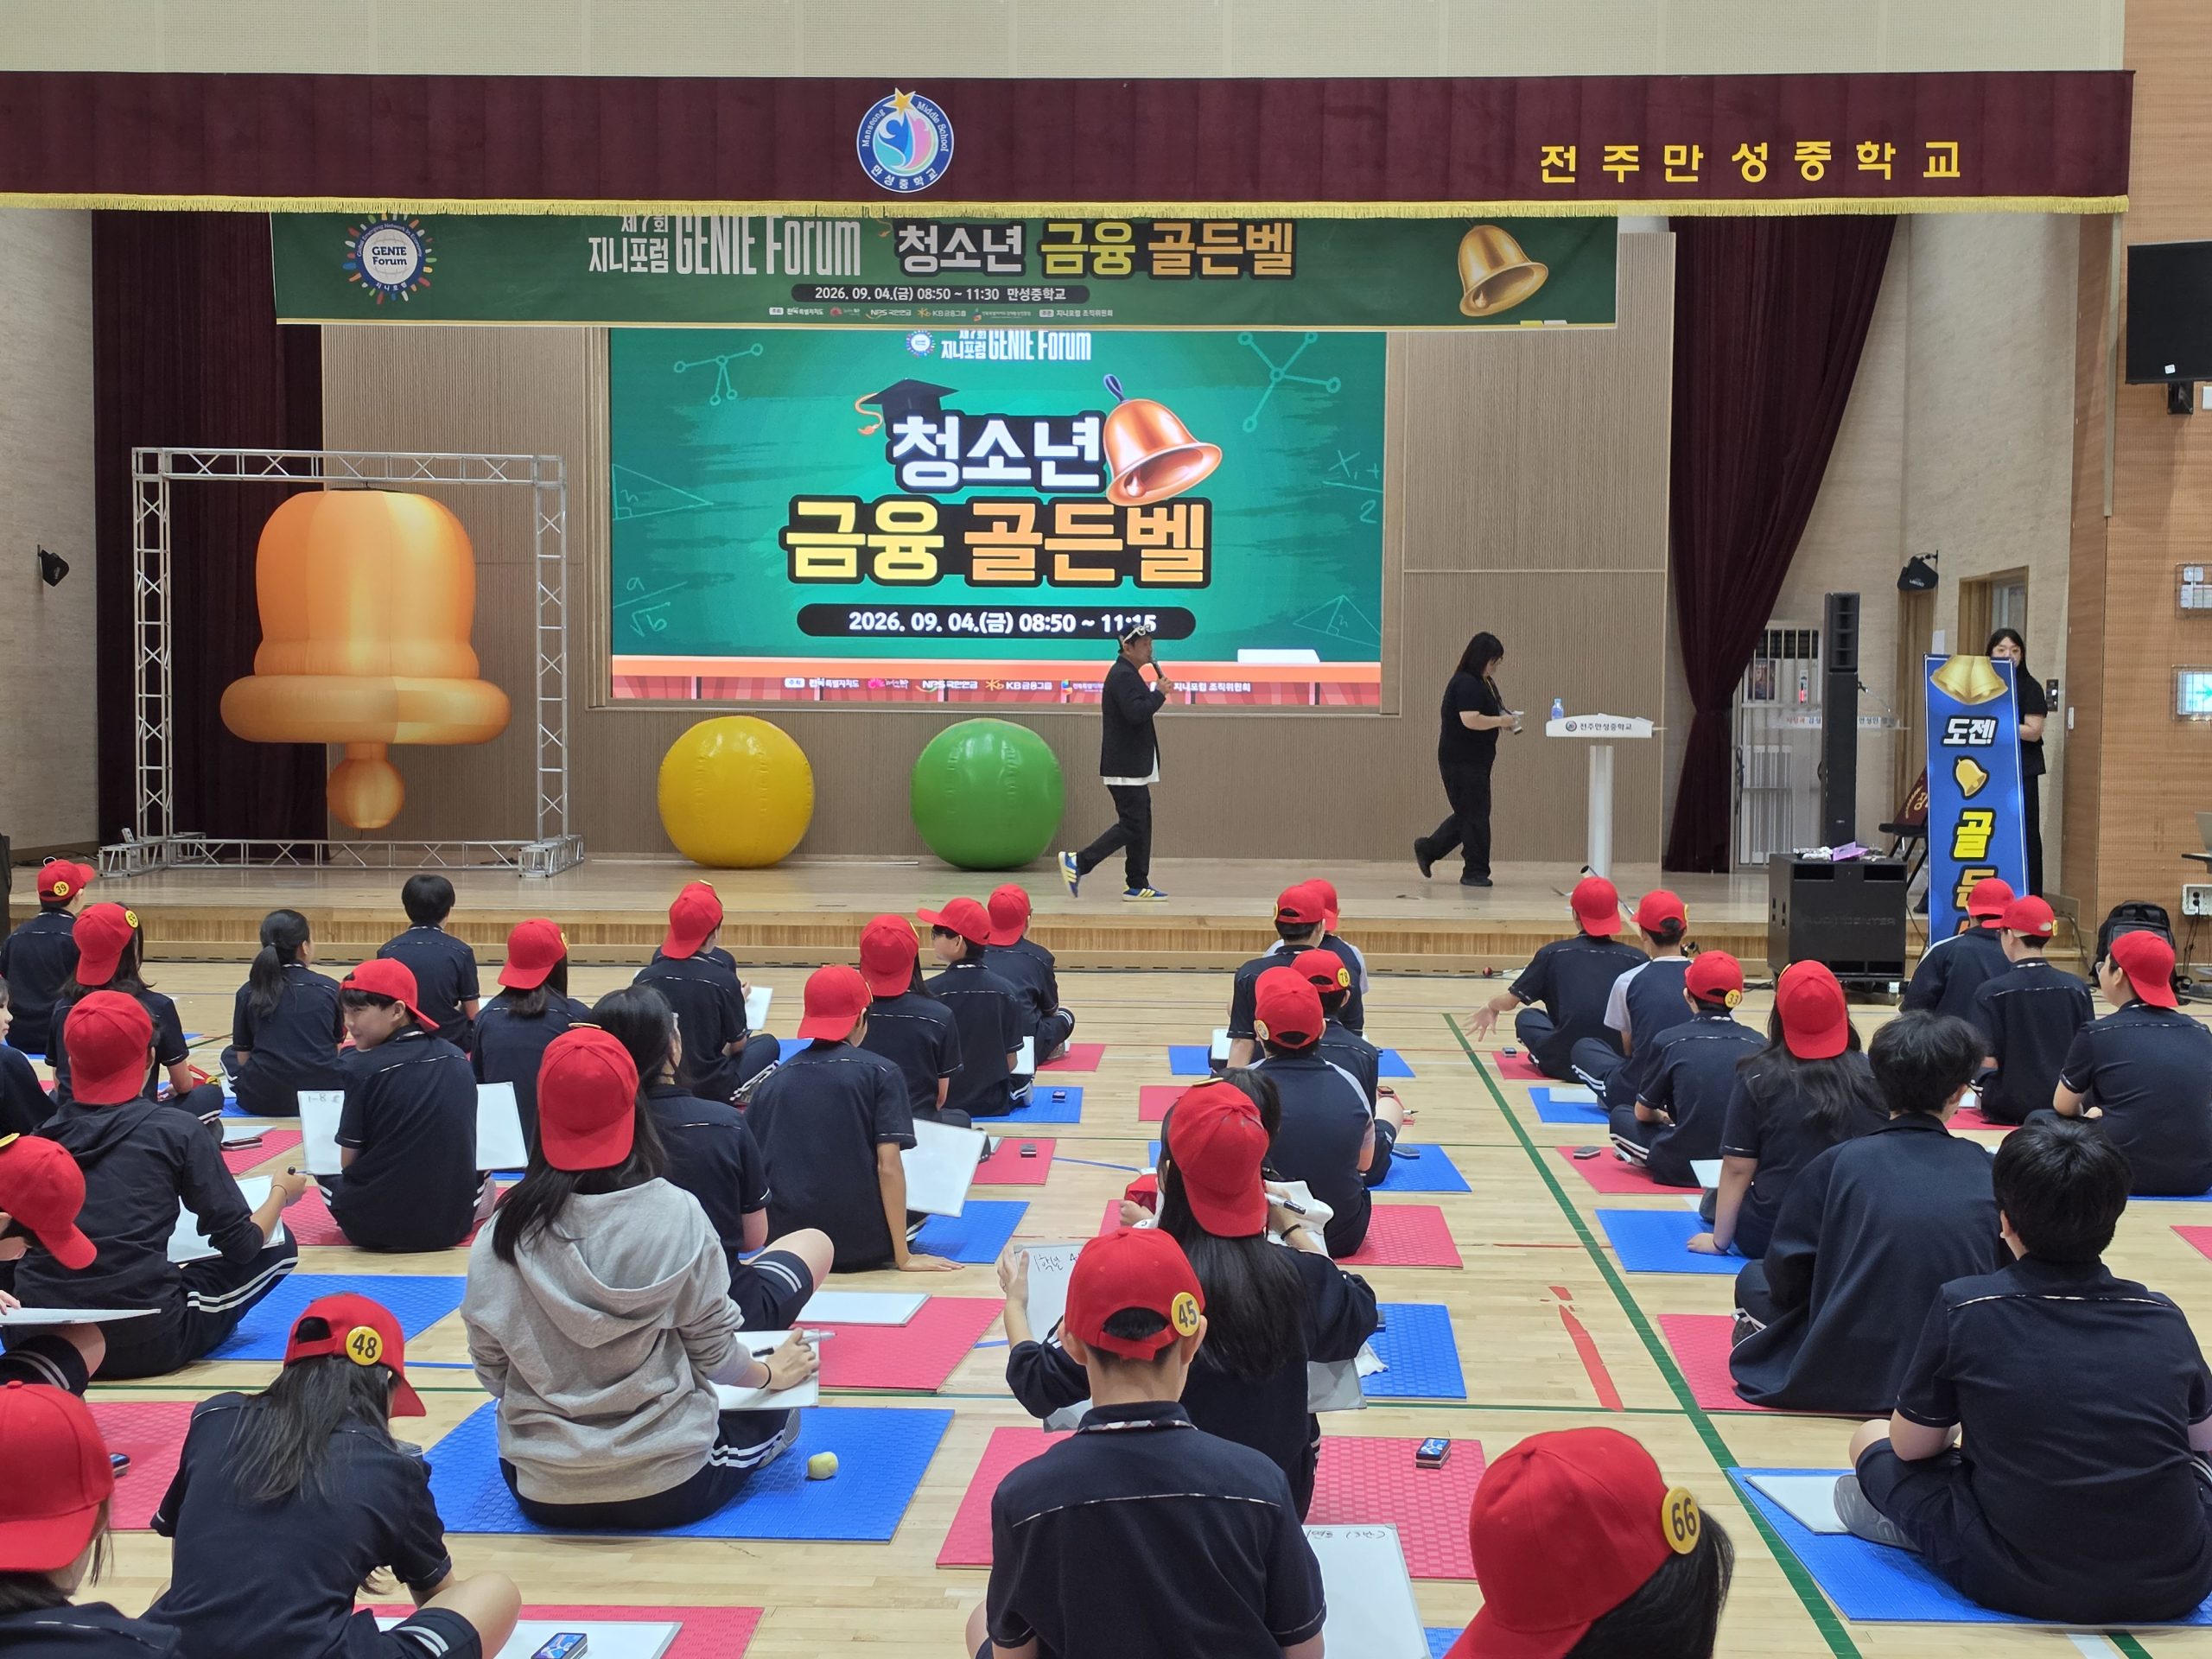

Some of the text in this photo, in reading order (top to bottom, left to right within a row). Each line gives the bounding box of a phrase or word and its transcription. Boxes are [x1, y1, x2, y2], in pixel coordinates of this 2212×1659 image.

[916, 101, 949, 152] Middle School
[1541, 141, 1961, 182] 전주만성중학교
[871, 164, 938, 189] 만성중학교
[372, 246, 407, 256] GENIE
[588, 237, 669, 273] 지니포럼
[676, 215, 861, 276] GENIE Forum
[898, 222, 1293, 276] 청소년 금융 골든벨
[372, 257, 407, 265] Forum
[815, 287, 849, 299] 2026.
[852, 288, 870, 300] 09.
[917, 289, 951, 300] 08:50
[966, 289, 999, 301] 11:30
[1007, 288, 1066, 301] 만성중학교
[941, 340, 987, 359] 지니포럼
[1039, 330, 1091, 360] Forum
[893, 416, 1103, 487] 청소년
[785, 499, 1205, 582] 금융 골든벨
[849, 611, 905, 632] 2026.
[911, 612, 943, 632] 09.
[1019, 613, 1073, 632] 08:50
[922, 681, 945, 690] NPS
[1173, 682, 1251, 692] 지니포럼 조직위원회
[55, 883, 67, 894] 39
[1339, 972, 1349, 984] 78
[1179, 1300, 1198, 1328] 45
[352, 1333, 378, 1359] 48
[1671, 1497, 1697, 1541] 66
